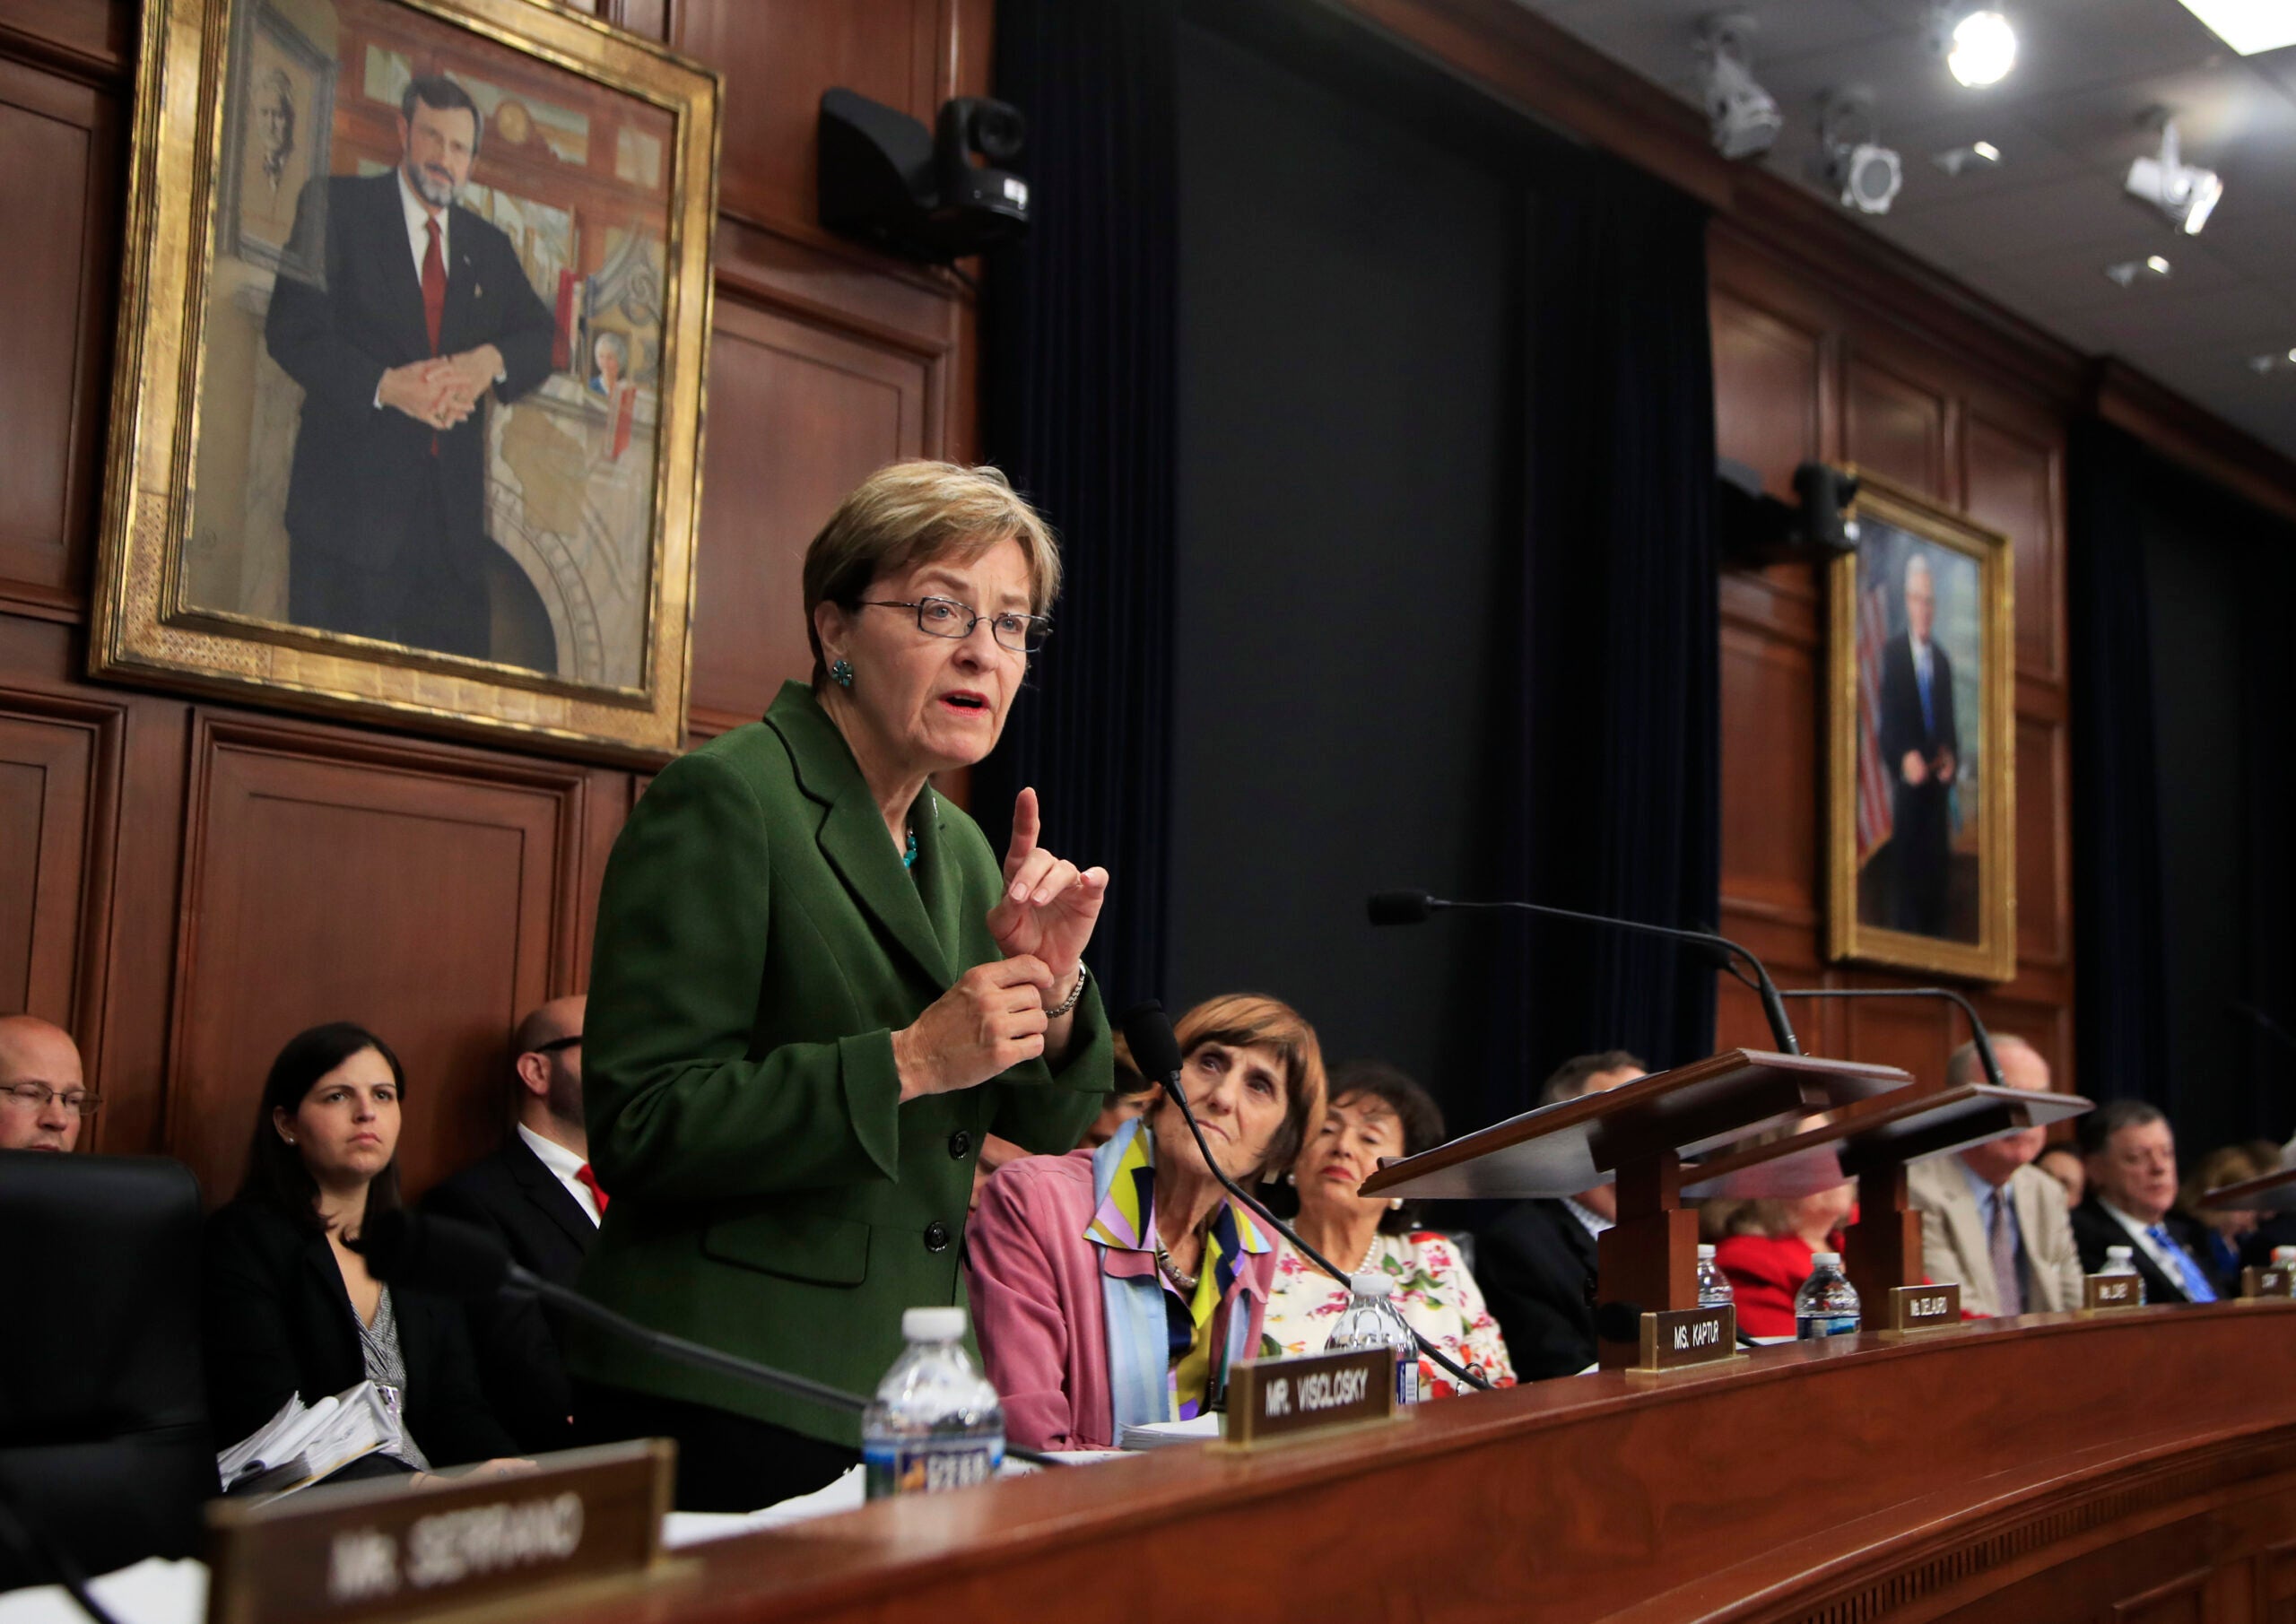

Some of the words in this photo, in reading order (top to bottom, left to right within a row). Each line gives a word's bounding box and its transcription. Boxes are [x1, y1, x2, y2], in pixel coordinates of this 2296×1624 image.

[1674, 1325, 1689, 1350] MS.
[1692, 1320, 1719, 1347] KAPTUR
[1265, 1377, 1292, 1417] MR.
[1297, 1368, 1369, 1411] VISCLOSKY
